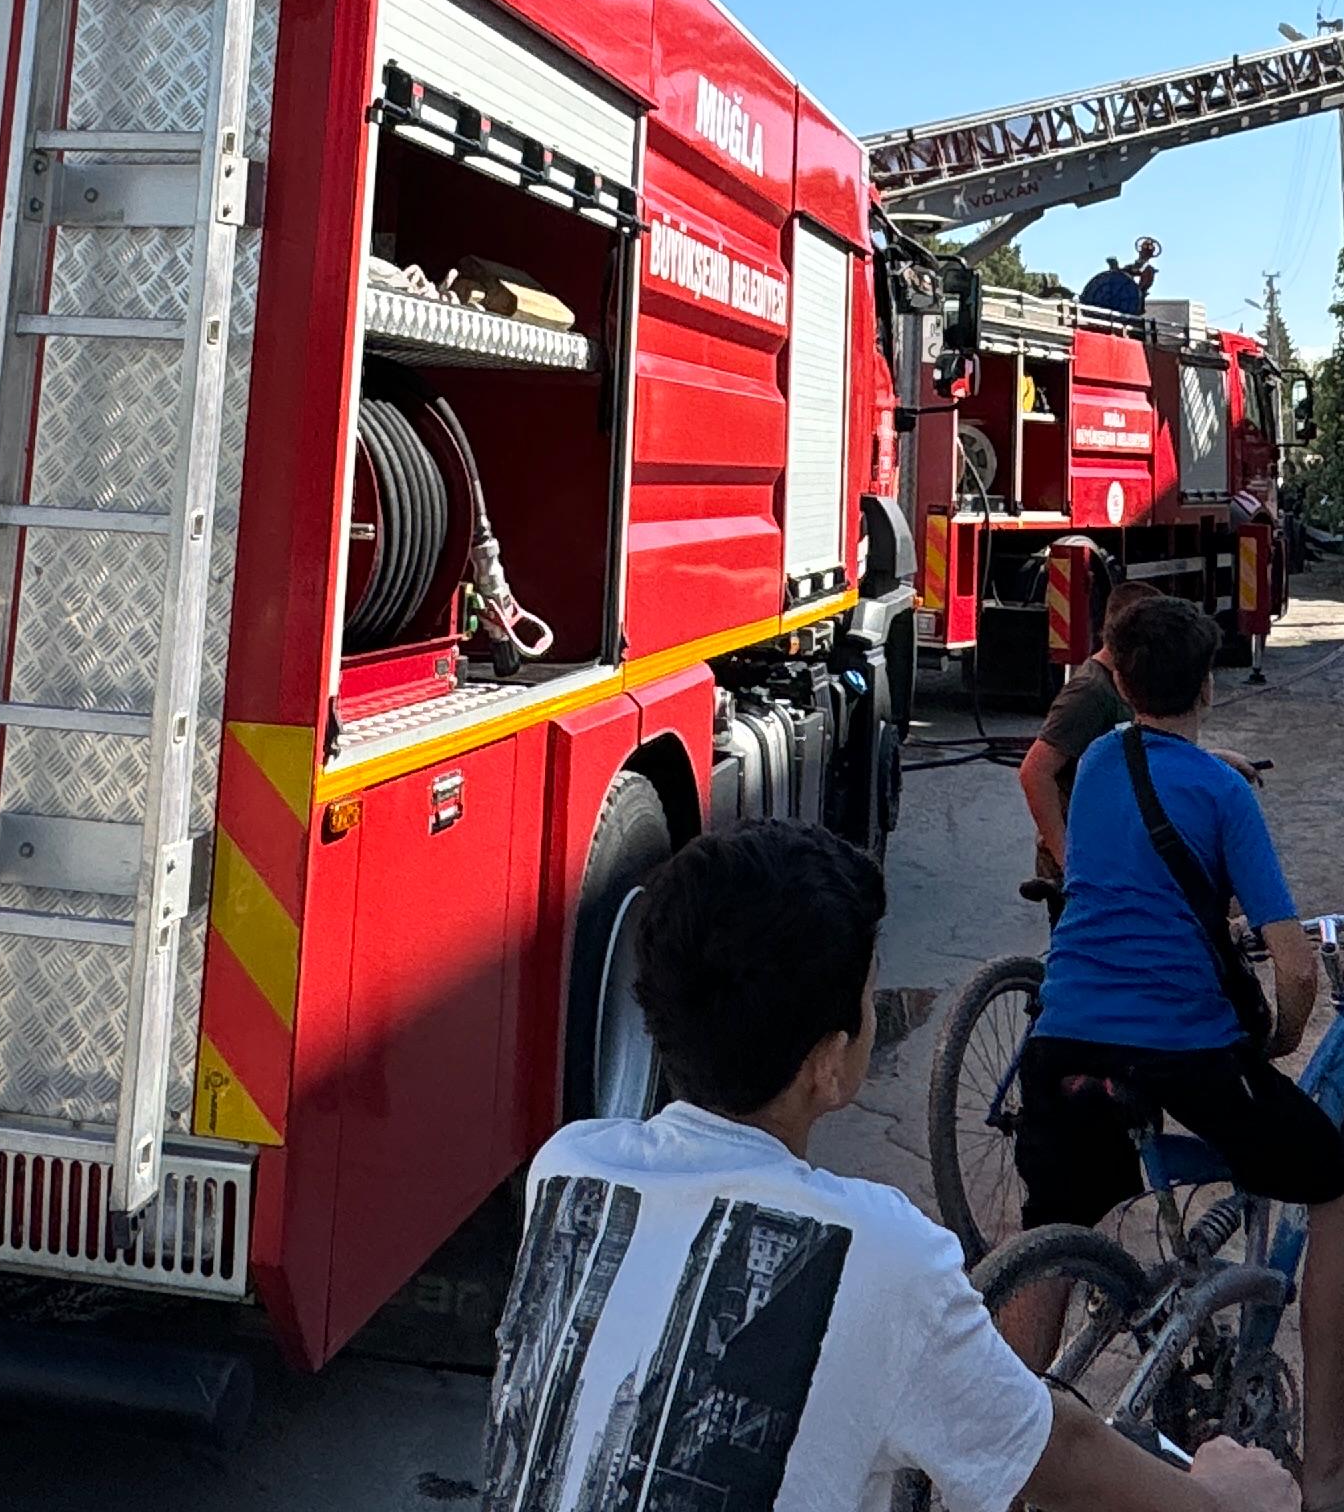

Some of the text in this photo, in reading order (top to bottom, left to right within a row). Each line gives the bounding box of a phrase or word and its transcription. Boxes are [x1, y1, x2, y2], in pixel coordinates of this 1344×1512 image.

[695, 74, 764, 178] MUĞLA
[969, 181, 1039, 208] VOLKAN
[650, 212, 787, 326] BÜYÜKŞEHİR BELEDİYESİ
